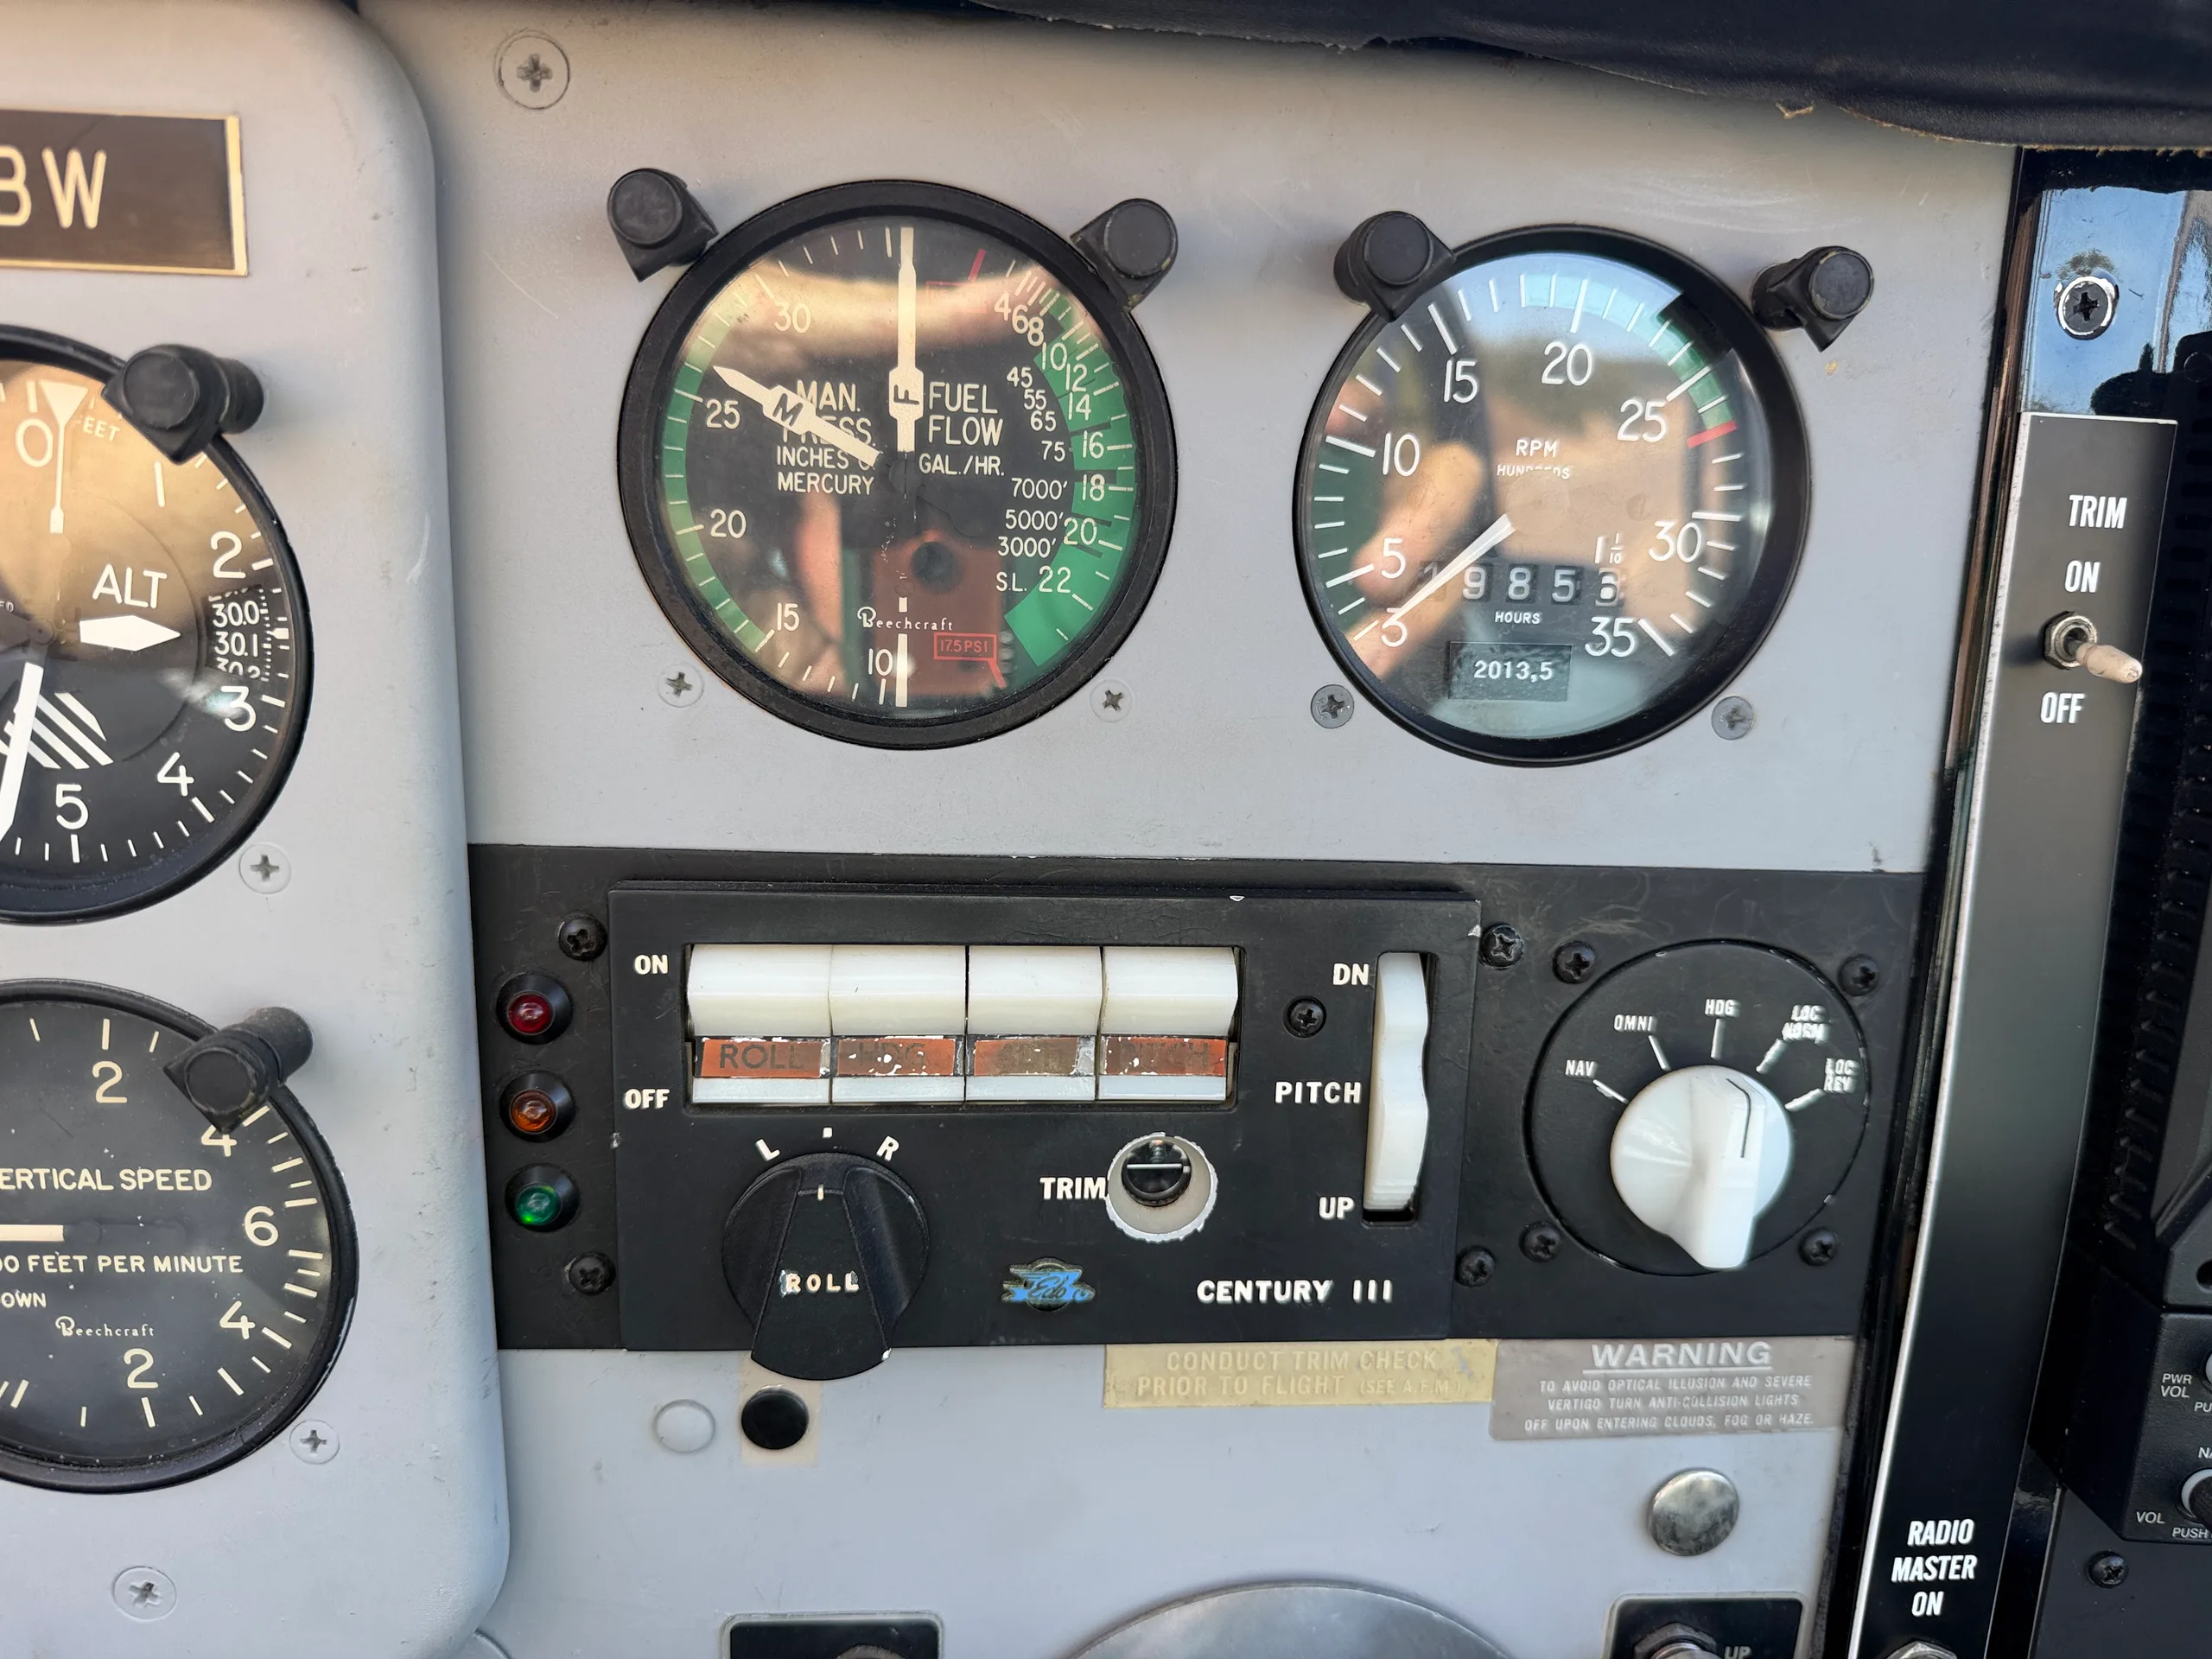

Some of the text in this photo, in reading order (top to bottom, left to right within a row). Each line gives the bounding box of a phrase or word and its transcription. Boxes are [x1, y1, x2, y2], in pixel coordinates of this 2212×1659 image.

[0, 146, 106, 229] BW
[774, 303, 811, 333] 30
[994, 291, 1011, 321] 4
[1012, 305, 1028, 334] 6
[1027, 316, 1044, 346] 8
[1042, 342, 1067, 371] 10
[1541, 341, 1592, 385] 20
[1007, 366, 1033, 388] 45
[1065, 363, 1087, 392] 12
[1444, 359, 1478, 403] 15
[797, 380, 861, 412] MAN.
[929, 382, 998, 413] FUEL
[1024, 389, 1047, 410] 55
[1069, 393, 1091, 420] 14
[706, 400, 740, 429] 25
[1030, 410, 1056, 432] 65
[1618, 399, 1666, 442] 25
[16, 418, 54, 467] 0
[929, 415, 1003, 446] FLOW
[1083, 430, 1104, 458] 16
[778, 446, 849, 469] INCHES
[1041, 441, 1065, 461] 75
[1382, 432, 1420, 476] 10
[1516, 439, 1559, 457] RPM
[918, 454, 1005, 476] GAL./HR.
[778, 472, 874, 495] MERCURY
[1082, 474, 1105, 501] 18
[710, 509, 747, 538] 20
[2069, 495, 2127, 529] TRIM
[1063, 518, 1096, 545] 20
[1649, 521, 1702, 563] 30
[211, 531, 246, 578] 2
[1382, 538, 1406, 579] 5
[92, 564, 167, 608] ALT
[1039, 566, 1071, 593] 22
[2064, 560, 2101, 593] ON
[212, 601, 259, 627] 30.0
[777, 603, 799, 631] 15
[857, 607, 952, 630] Beechcraft
[1381, 608, 1408, 647] 3
[1495, 612, 1541, 624] HOURS
[214, 632, 258, 657] 30.1
[964, 640, 988, 653] PSI
[1585, 617, 1636, 657] 35
[868, 649, 893, 676] 10
[221, 686, 256, 731] 3
[2040, 691, 2085, 723] OFF
[157, 753, 194, 796] 4
[56, 784, 88, 830] 5
[634, 954, 669, 975] ON
[1332, 963, 1370, 985] DN
[1705, 999, 1739, 1017] HDG
[1613, 1014, 1657, 1033] OMNI
[719, 1043, 805, 1070] ROLL
[1566, 1059, 1597, 1077] NAV
[92, 1061, 127, 1103] 2
[1274, 1081, 1362, 1103] PITCH
[624, 1088, 671, 1109] OFF
[201, 1125, 237, 1156] 4
[754, 1139, 780, 1161] L
[876, 1135, 899, 1161] R
[119, 1169, 213, 1190] SPEED
[1039, 1177, 1107, 1199] TRIM
[1319, 1197, 1355, 1219] UP
[245, 1206, 278, 1246] 6
[28, 1255, 87, 1273] FEET
[98, 1255, 145, 1273] PER
[154, 1255, 243, 1273] MINUTE
[785, 1272, 860, 1293] ROLL
[1198, 1280, 1332, 1303] CENTURY
[55, 1316, 155, 1338] Beechcraft
[219, 1300, 256, 1339] 4
[1167, 1350, 1438, 1372] CONDUCT TRIM CHECK
[1591, 1341, 1773, 1367] WARNING
[124, 1349, 158, 1389] 2
[2162, 1373, 2192, 1384] PWR
[1137, 1376, 1207, 1396] PRIOR
[1220, 1376, 1248, 1395] TO
[1261, 1375, 1344, 1395] FLIGHT
[1539, 1375, 1813, 1393] TO AVOID OPTICAL ILLUSION AND SEVERE
[2160, 1385, 2190, 1398] VOL
[1548, 1394, 1801, 1410] VERTIGO TURN ANTI-COLLISION LIGHTS
[1525, 1419, 1548, 1431] OFF
[1555, 1418, 1590, 1430] UPON
[1597, 1416, 1657, 1429] ENTERING
[1724, 1414, 1748, 1426] FOG
[1755, 1414, 1772, 1426] OR
[2136, 1511, 2164, 1524] VOL
[1907, 1518, 1974, 1547] RADIO
[2172, 1528, 2208, 1539] PUSH
[1891, 1554, 1978, 1583] MASTER
[1911, 1591, 1944, 1617] ON
